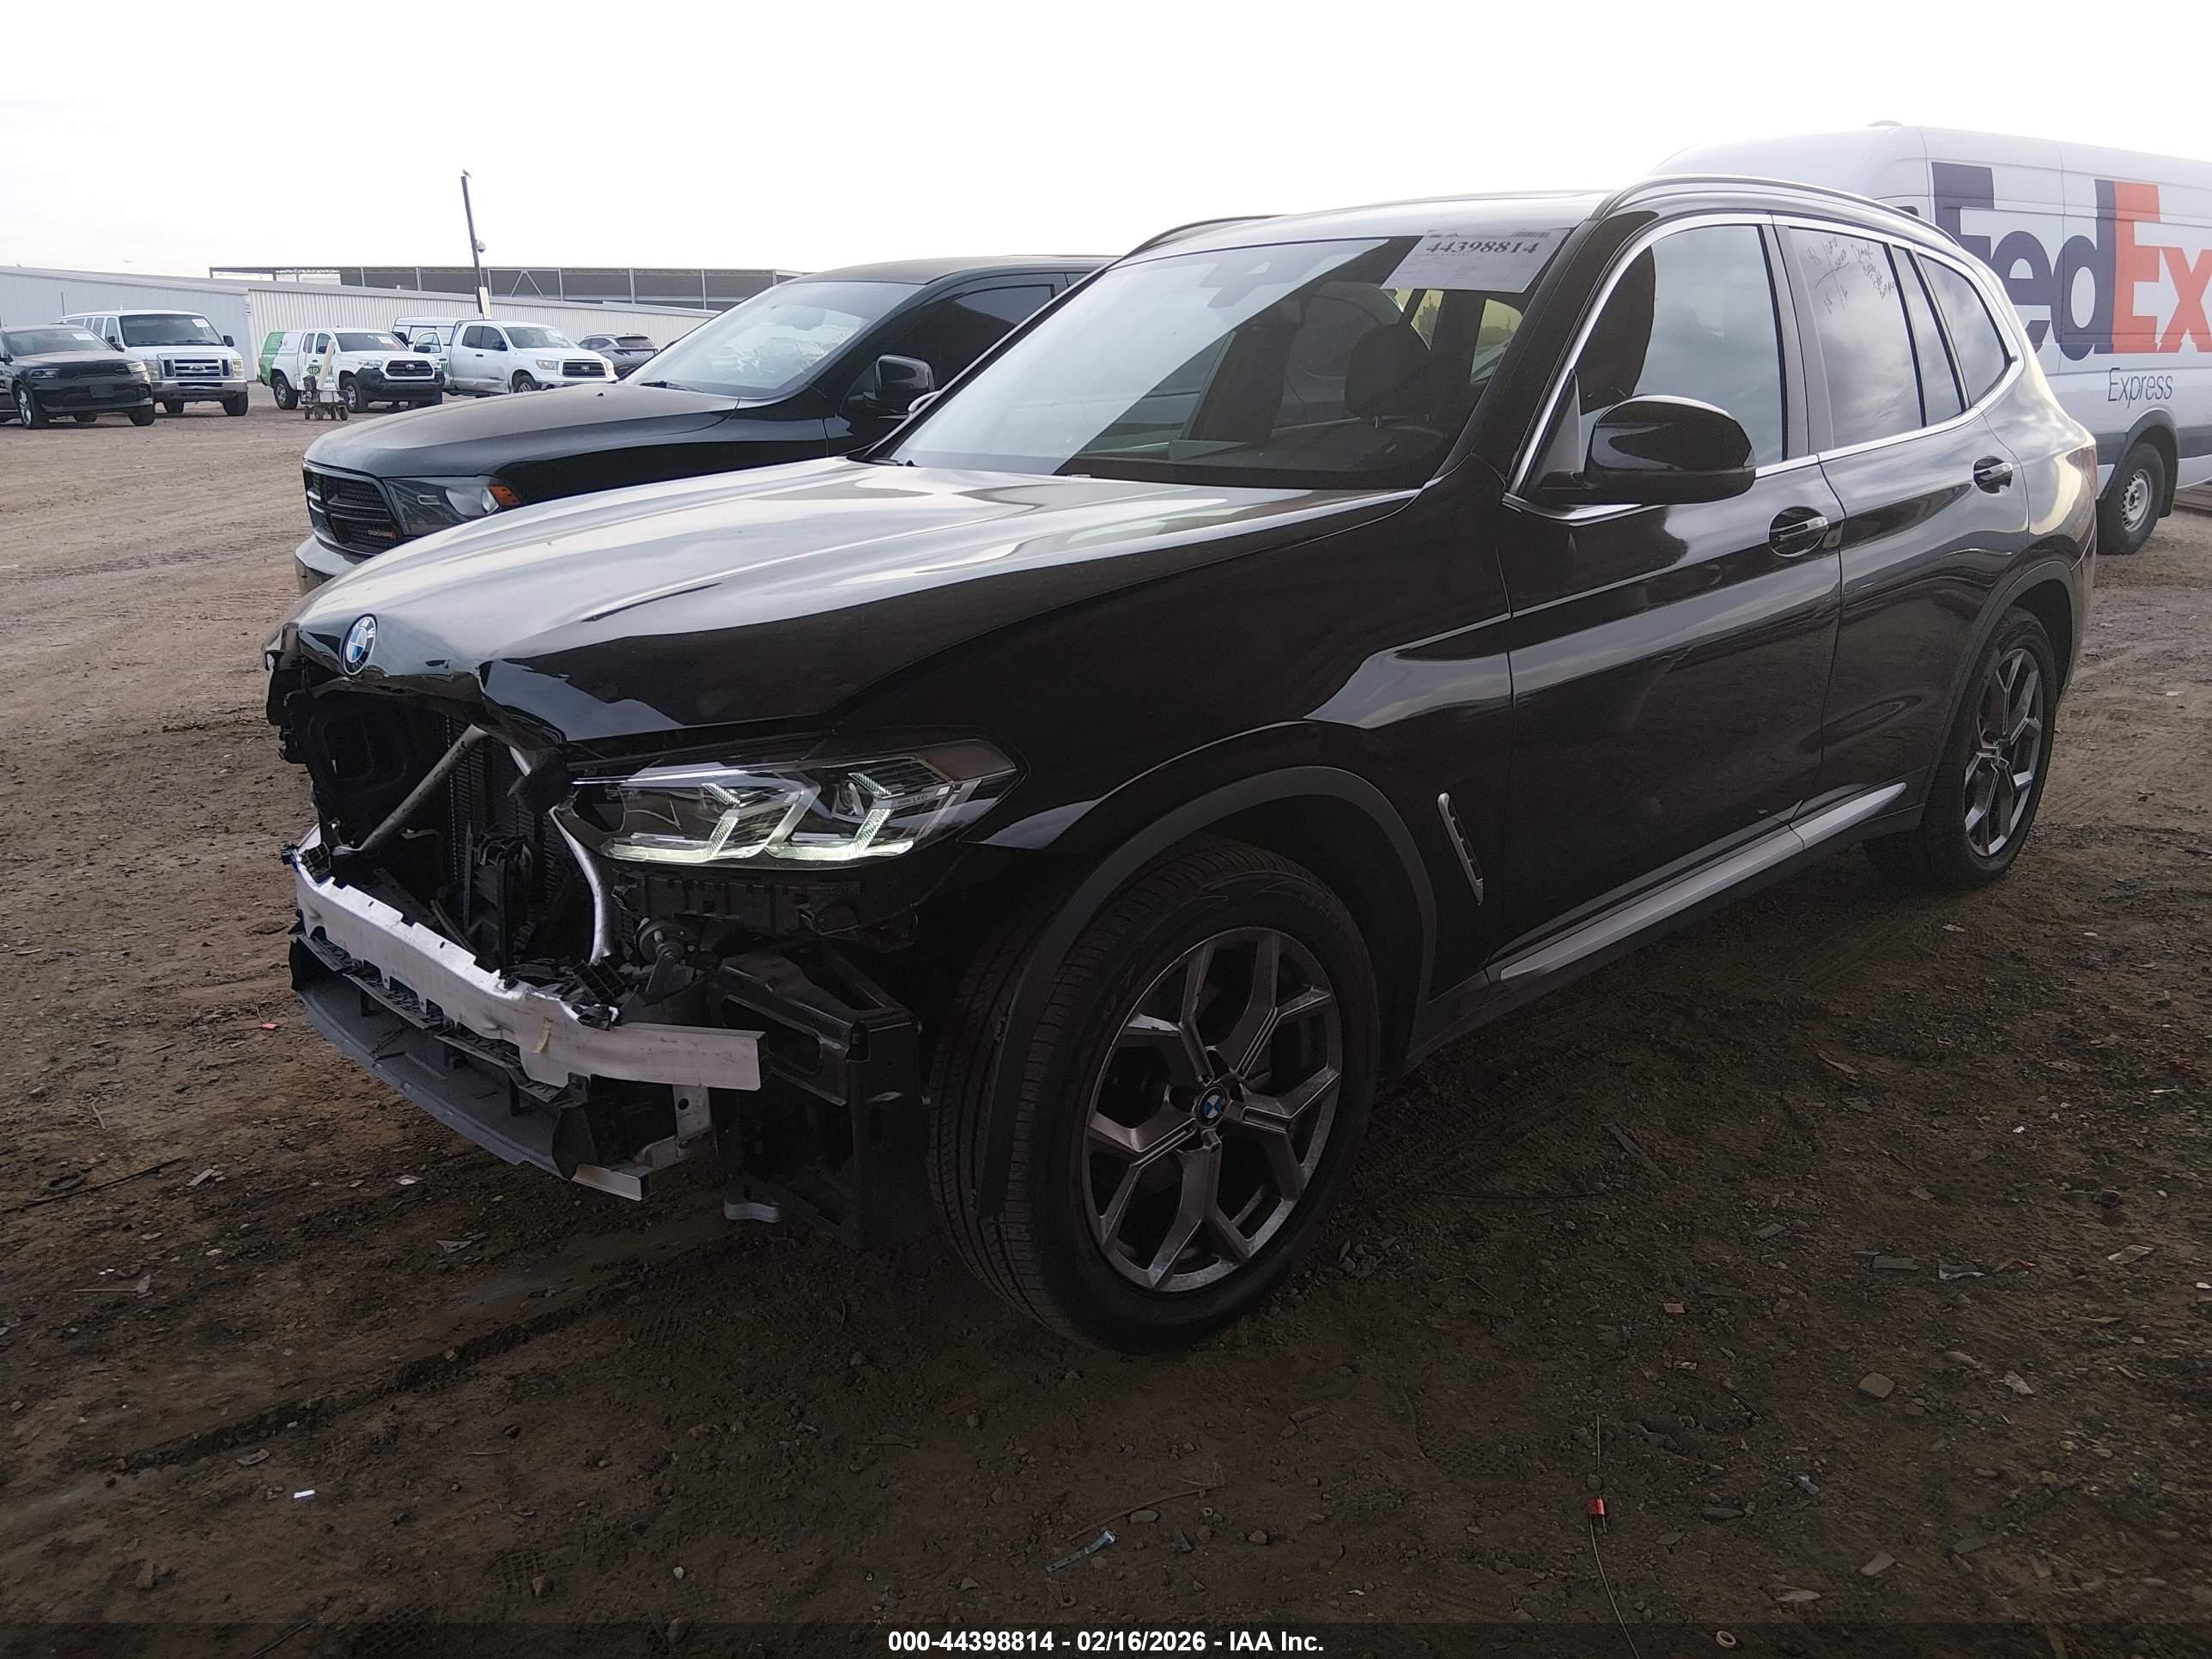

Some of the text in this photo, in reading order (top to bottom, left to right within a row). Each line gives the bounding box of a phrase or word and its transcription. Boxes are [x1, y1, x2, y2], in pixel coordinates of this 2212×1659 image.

[1426, 241, 1540, 253] 44398814
[1931, 161, 2212, 361] FedEx
[2108, 367, 2173, 410] Express
